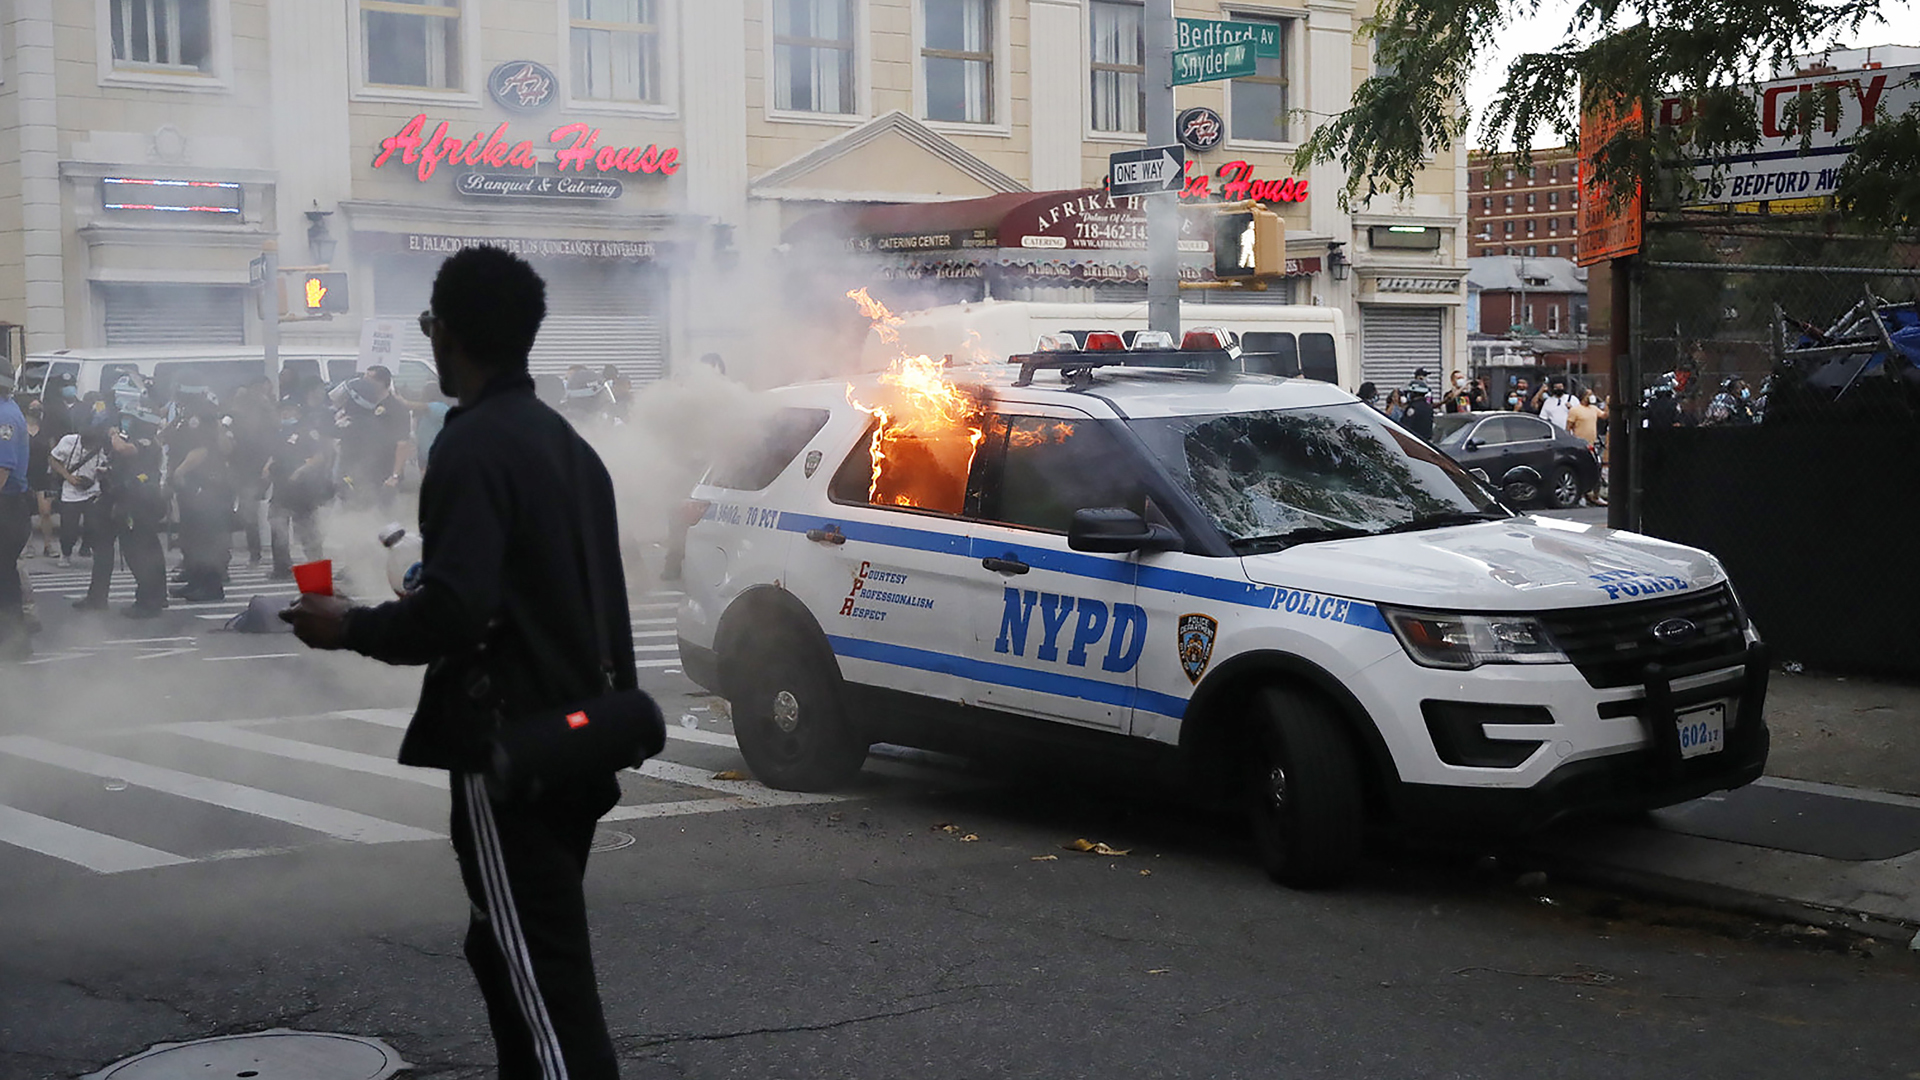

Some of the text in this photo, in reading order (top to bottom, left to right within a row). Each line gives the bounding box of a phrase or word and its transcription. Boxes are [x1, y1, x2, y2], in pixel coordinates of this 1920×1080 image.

[1180, 22, 1273, 47] Bedford Av
[1181, 46, 1246, 80] Snyder Av
[1762, 75, 1887, 137] CITY
[372, 113, 681, 182] Afrika House
[1117, 165, 1136, 181] ONE
[1142, 161, 1164, 179] WAY
[1217, 160, 1309, 202] House
[1731, 171, 1810, 197] BEDFORD
[464, 174, 617, 197] Banquet & Catering
[1037, 194, 1116, 232] AFRIKA
[409, 235, 420, 250] EL
[423, 236, 461, 252] PALACIO
[878, 236, 917, 249] CATERING
[919, 235, 950, 247] CENTER
[1076, 223, 1148, 240] 718-462-14
[1598, 576, 1688, 600] POLICE
[1271, 587, 1350, 622] POLICE
[994, 587, 1148, 673] NYPD
